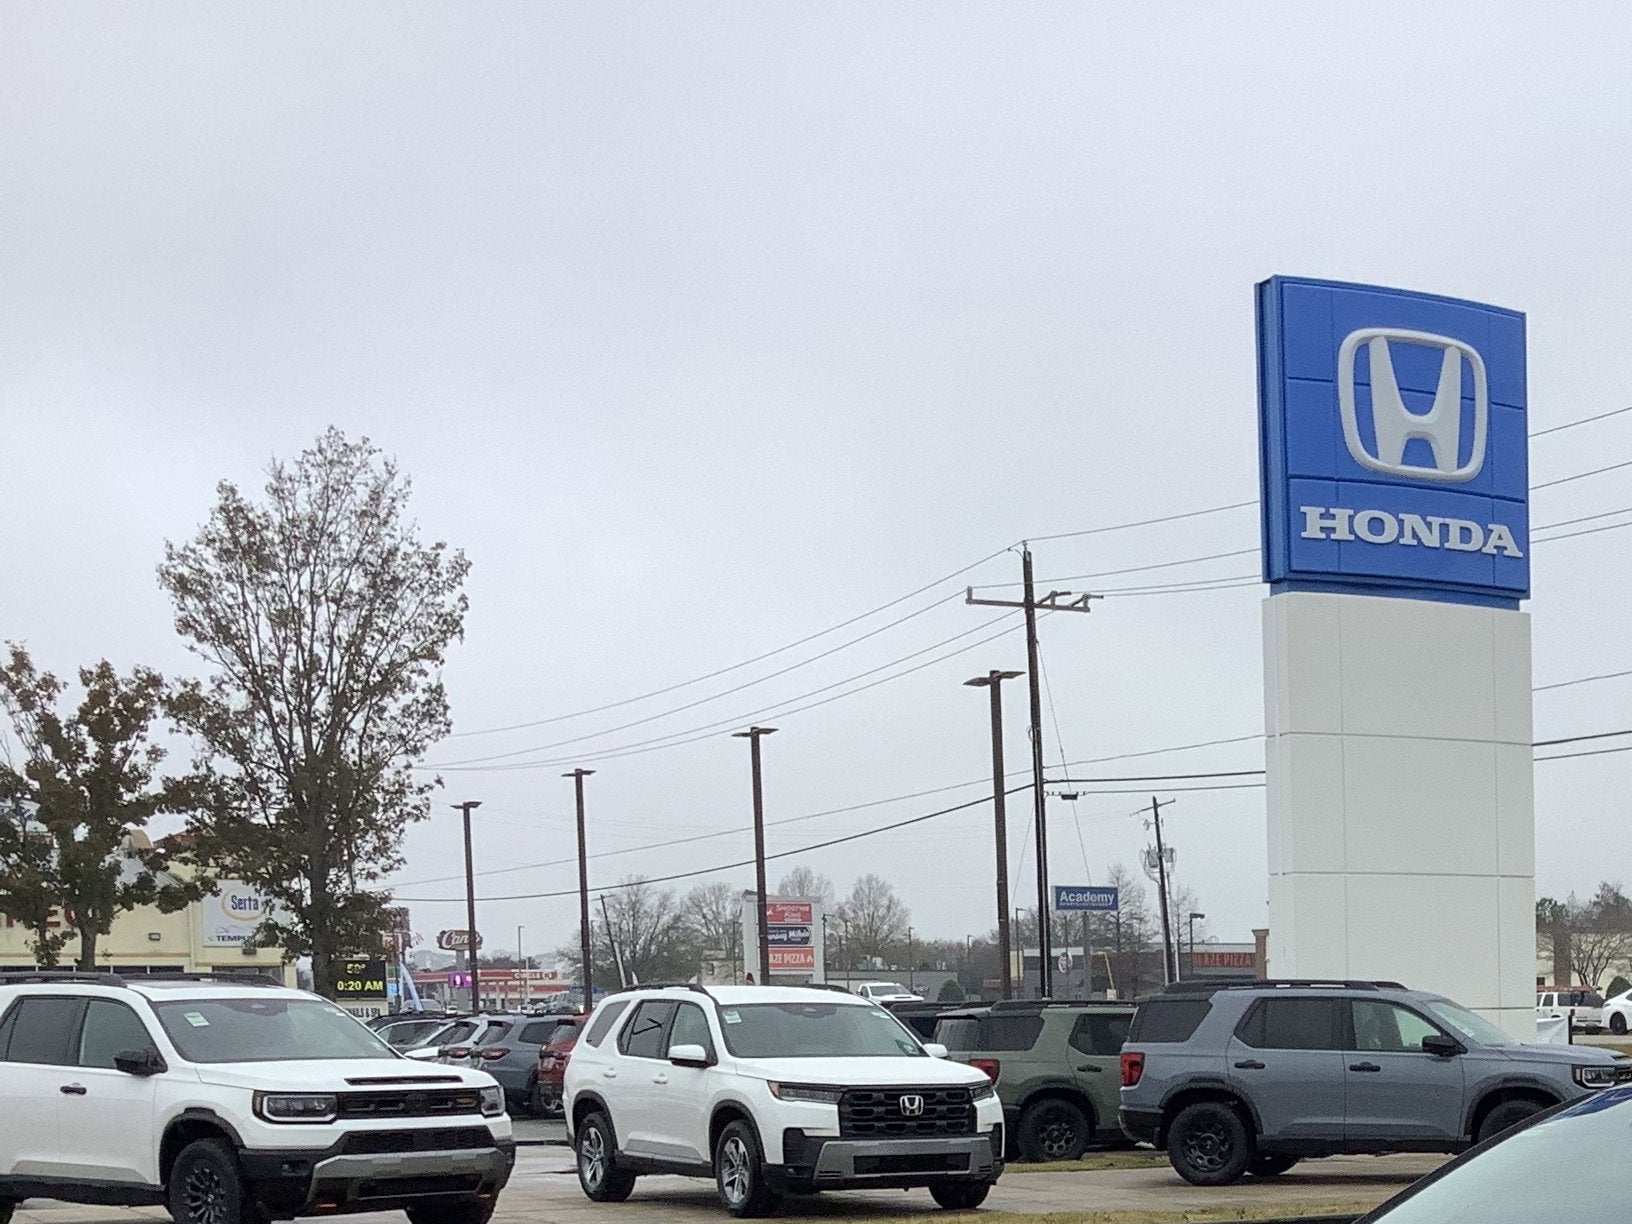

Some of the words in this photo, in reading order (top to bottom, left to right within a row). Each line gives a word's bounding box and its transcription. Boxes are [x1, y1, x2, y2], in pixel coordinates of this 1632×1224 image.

[1300, 505, 1523, 558] HONDA
[231, 894, 259, 911] Serta
[1059, 891, 1115, 906] Academy
[768, 953, 783, 964] AZE
[784, 953, 806, 965] PIZZA
[336, 981, 362, 991] 0:20
[364, 981, 384, 991] AM
